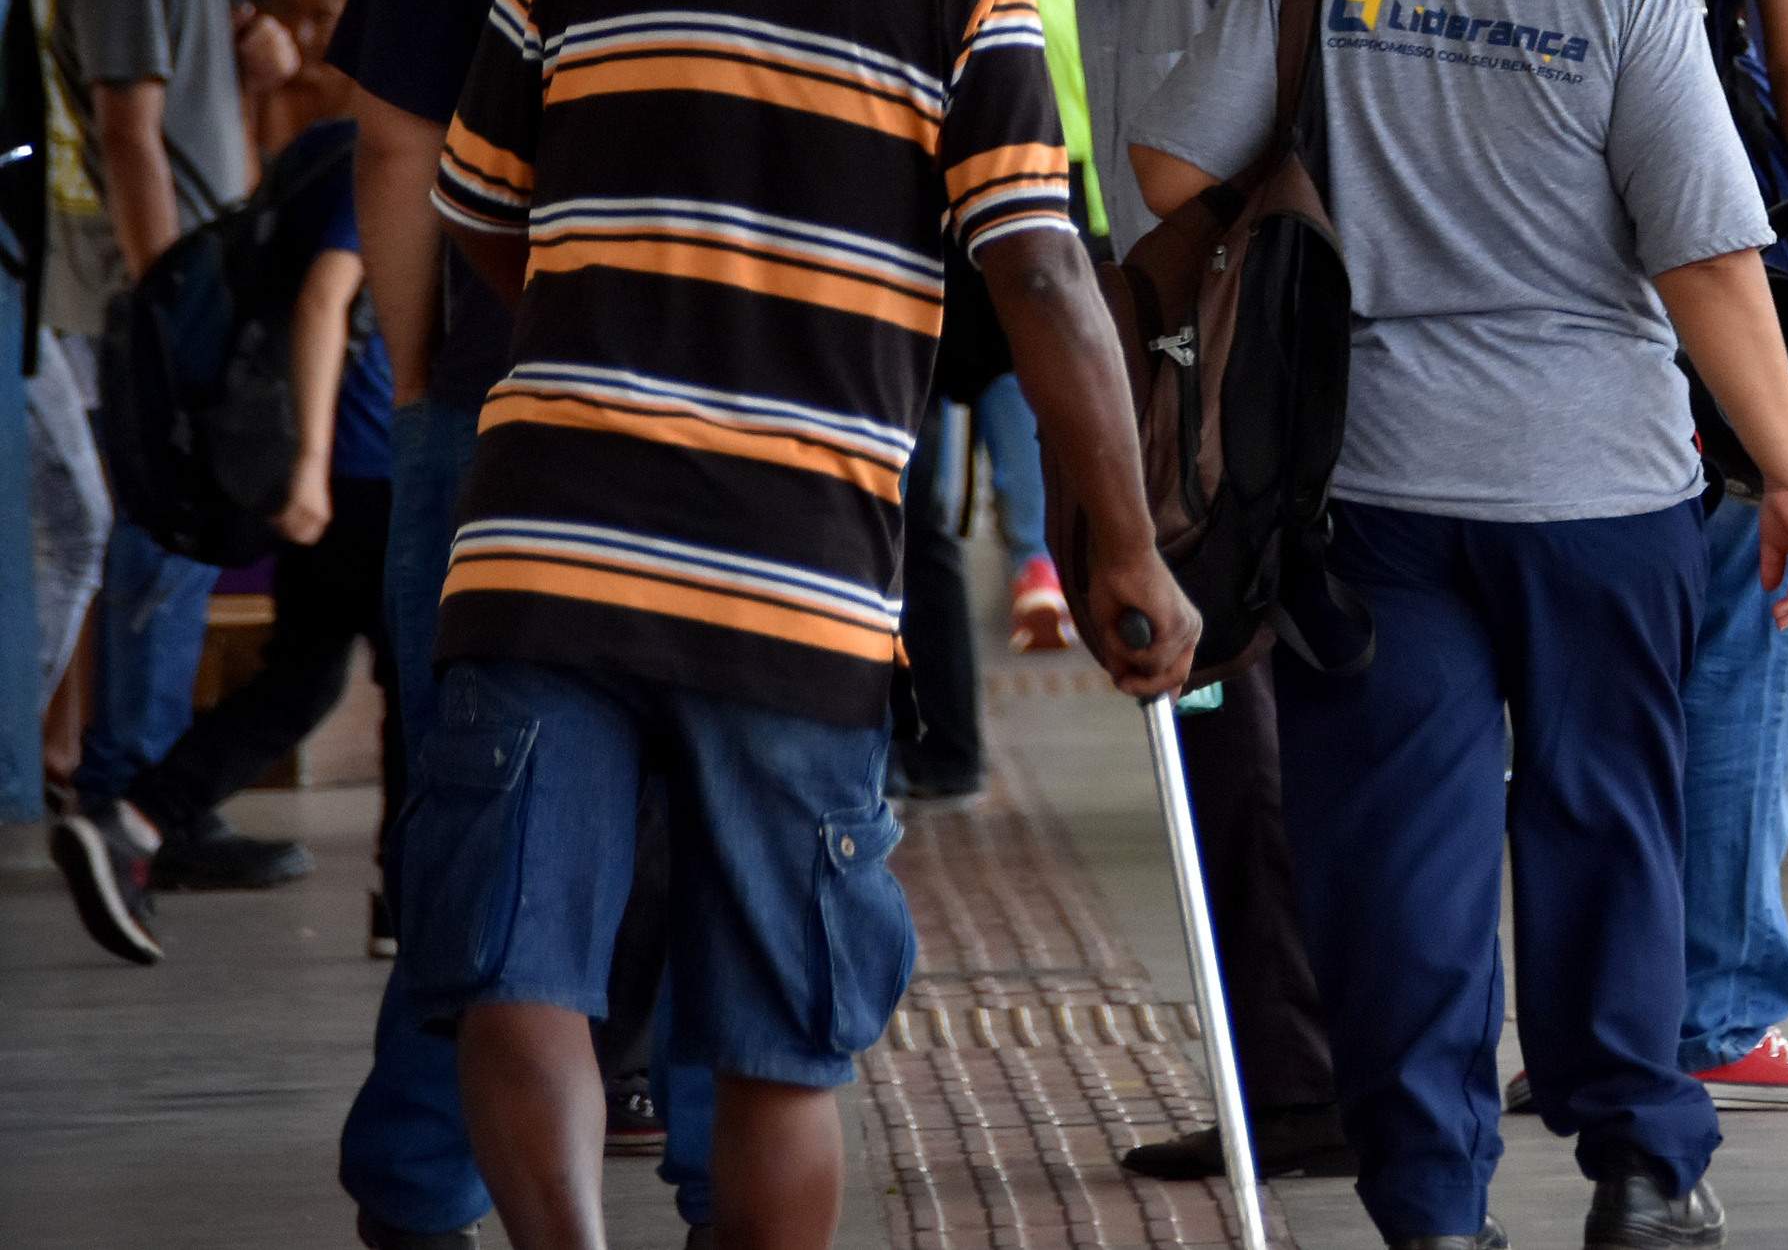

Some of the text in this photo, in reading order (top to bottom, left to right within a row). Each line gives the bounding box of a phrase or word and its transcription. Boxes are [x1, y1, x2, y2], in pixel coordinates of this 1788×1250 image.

[1327, 37, 1584, 85] COMPROMISSO COM SEU BEM-ESTAR
